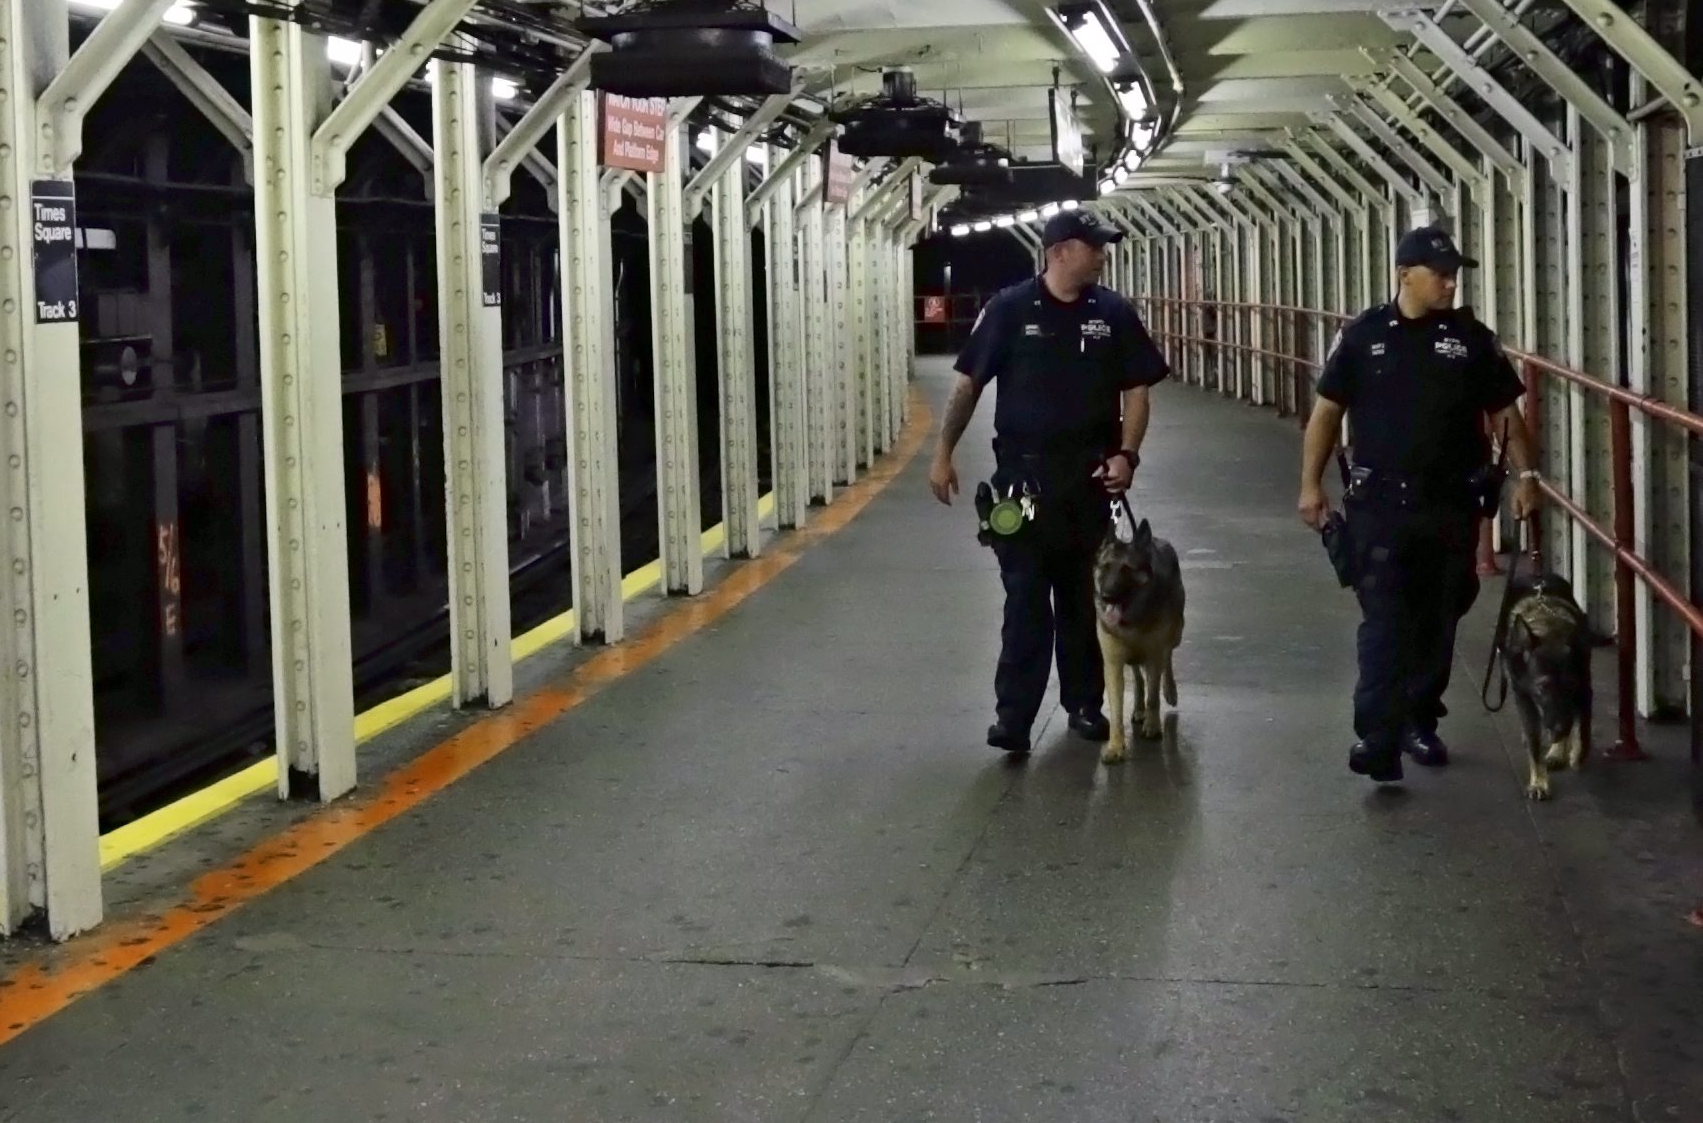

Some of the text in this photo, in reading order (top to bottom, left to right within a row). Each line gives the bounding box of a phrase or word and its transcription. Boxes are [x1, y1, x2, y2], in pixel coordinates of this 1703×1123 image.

[34, 203, 66, 222] Times
[34, 223, 72, 244] Square
[37, 300, 77, 319] Track 3
